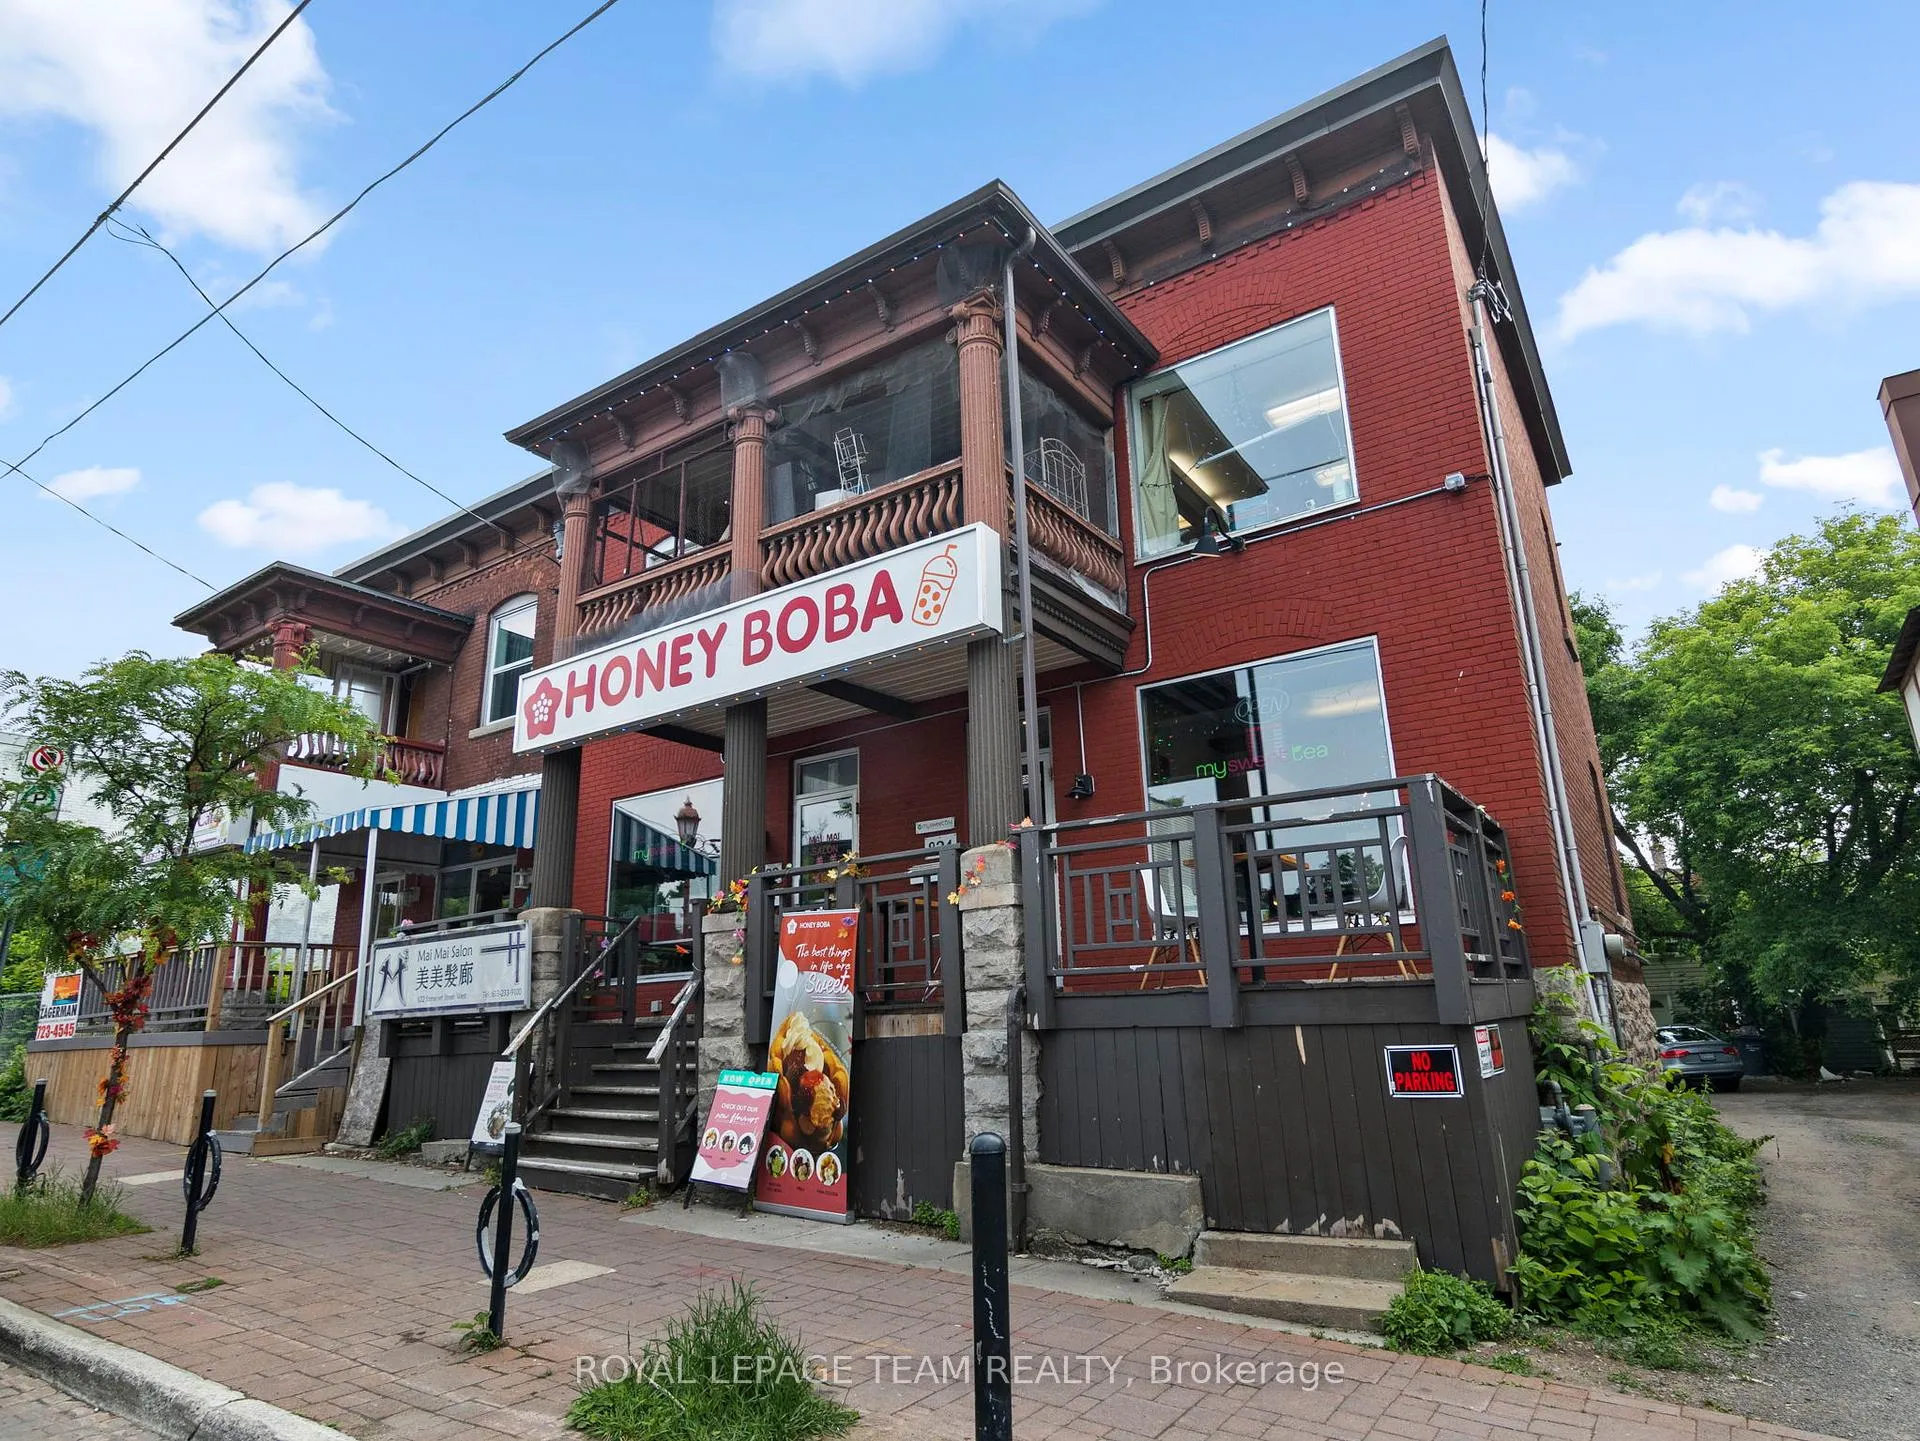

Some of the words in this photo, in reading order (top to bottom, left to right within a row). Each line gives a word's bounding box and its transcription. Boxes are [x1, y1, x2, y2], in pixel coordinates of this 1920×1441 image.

[565, 622, 727, 718] HONEY
[743, 569, 904, 667] BOBA
[1237, 693, 1283, 718] OPEN
[417, 950, 433, 962] Mai
[434, 947, 450, 960] Mai
[451, 944, 473, 958] Salon
[796, 944, 810, 958] The
[811, 944, 828, 957] best
[829, 944, 852, 962] things
[415, 961, 474, 990] 美美髮廊
[810, 961, 818, 970] in
[819, 961, 833, 974] life
[836, 962, 851, 970] are
[805, 969, 849, 993] Sweet
[40, 1004, 78, 1019] ZAGERMAN
[1410, 1051, 1431, 1071] NO
[723, 1074, 744, 1083] NOW
[748, 1075, 773, 1085] OPEN
[1394, 1071, 1455, 1091] PARKING
[721, 1102, 736, 1110] CHECK
